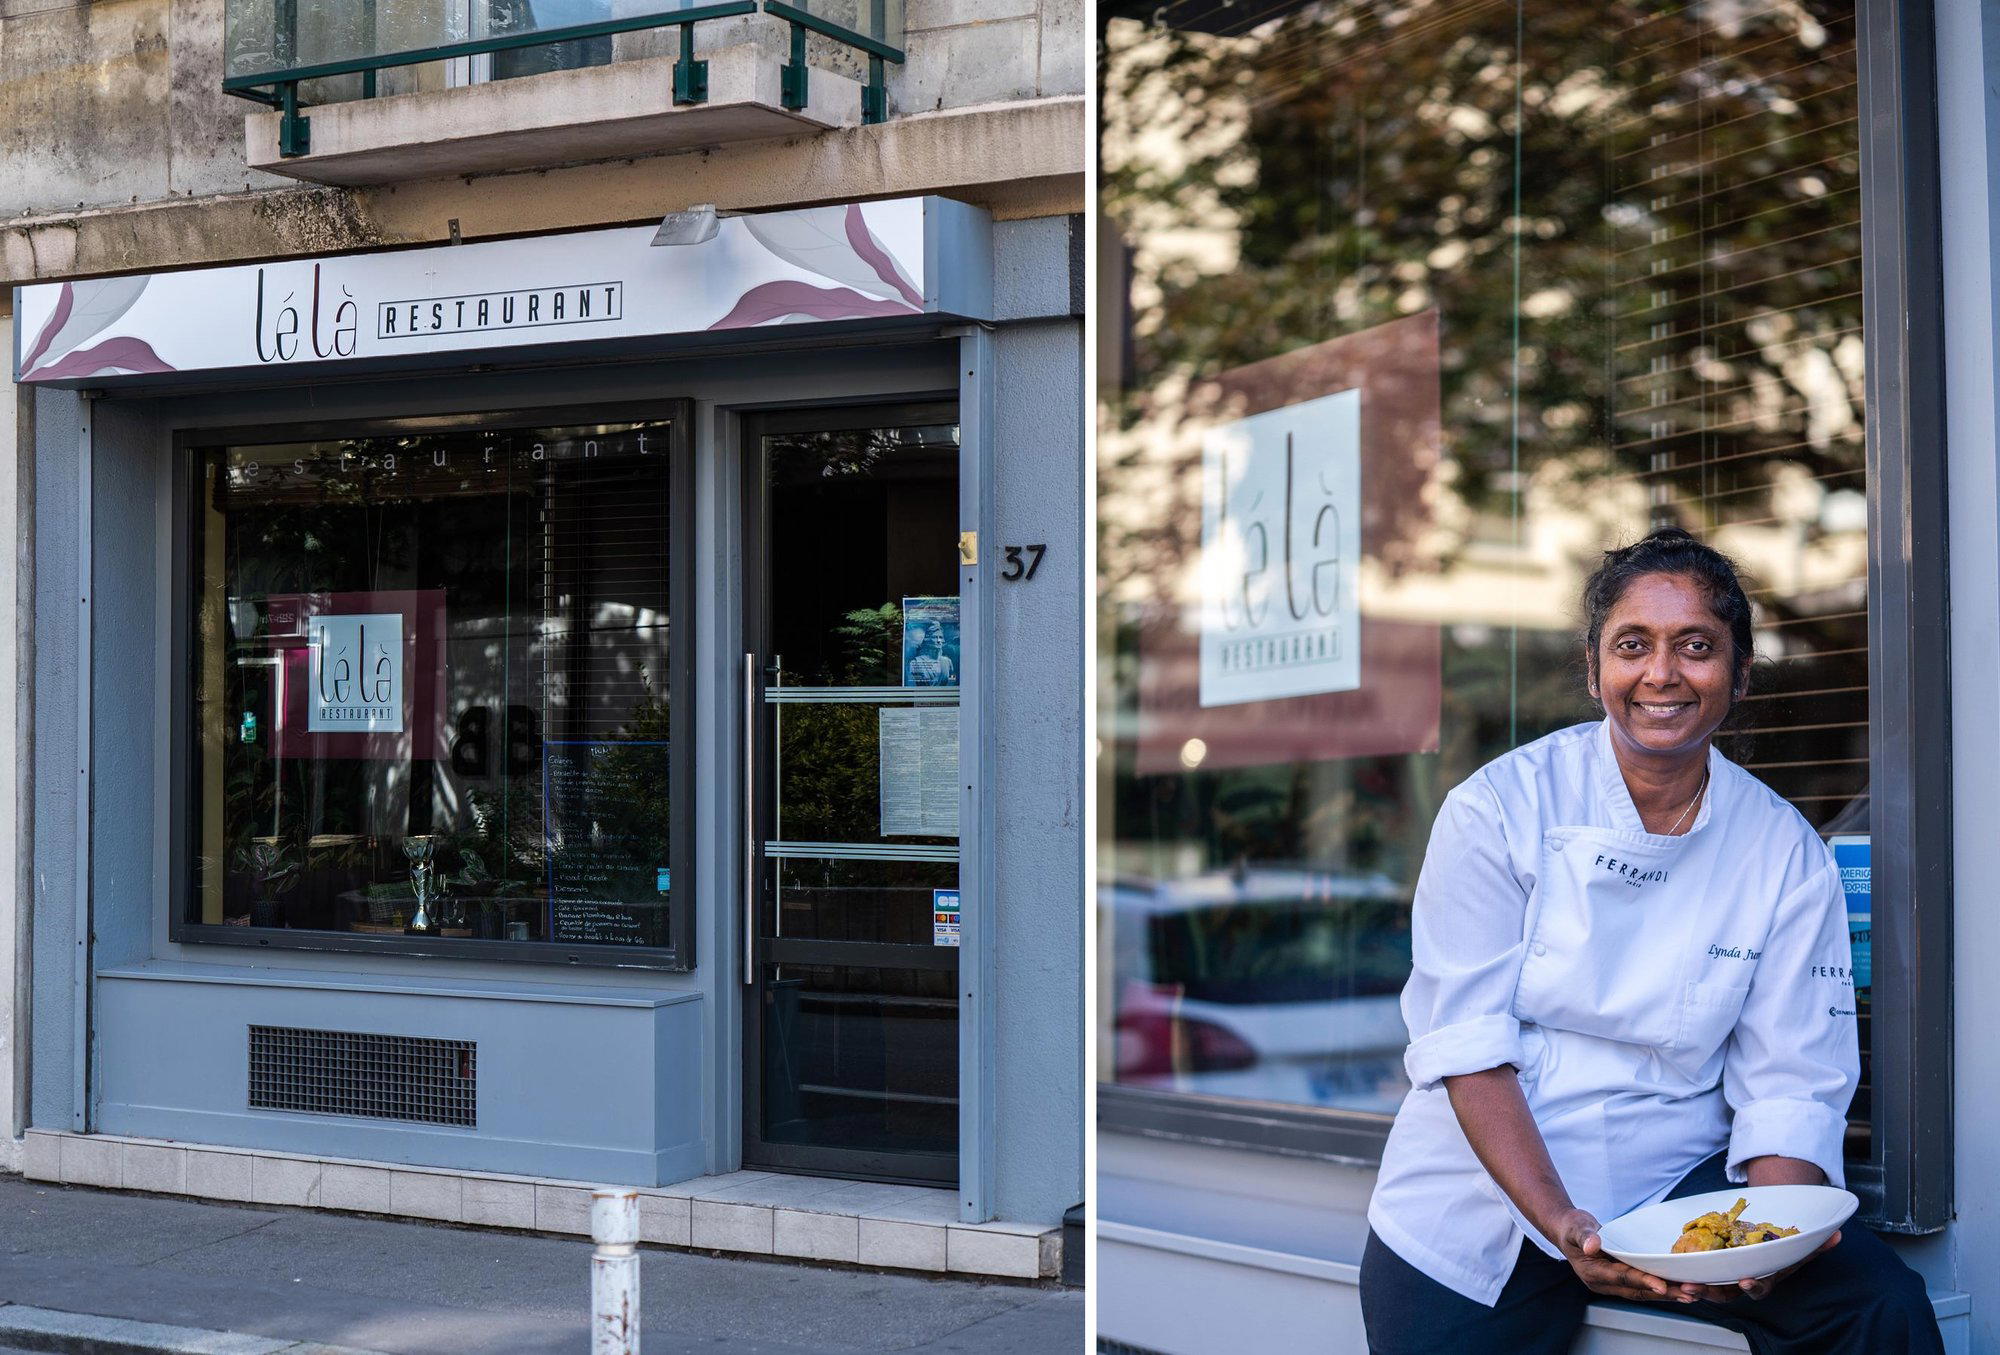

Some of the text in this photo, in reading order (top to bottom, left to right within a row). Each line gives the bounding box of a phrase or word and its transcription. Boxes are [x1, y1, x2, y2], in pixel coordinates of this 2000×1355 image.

[385, 287, 615, 334] RESTAURANT
[1002, 543, 1047, 581] 37
[321, 708, 392, 719] RESTAURANT
[1595, 855, 1668, 883] FERRANDI
[1708, 943, 1741, 960] Lynda
[1811, 966, 1854, 978] FERRA
